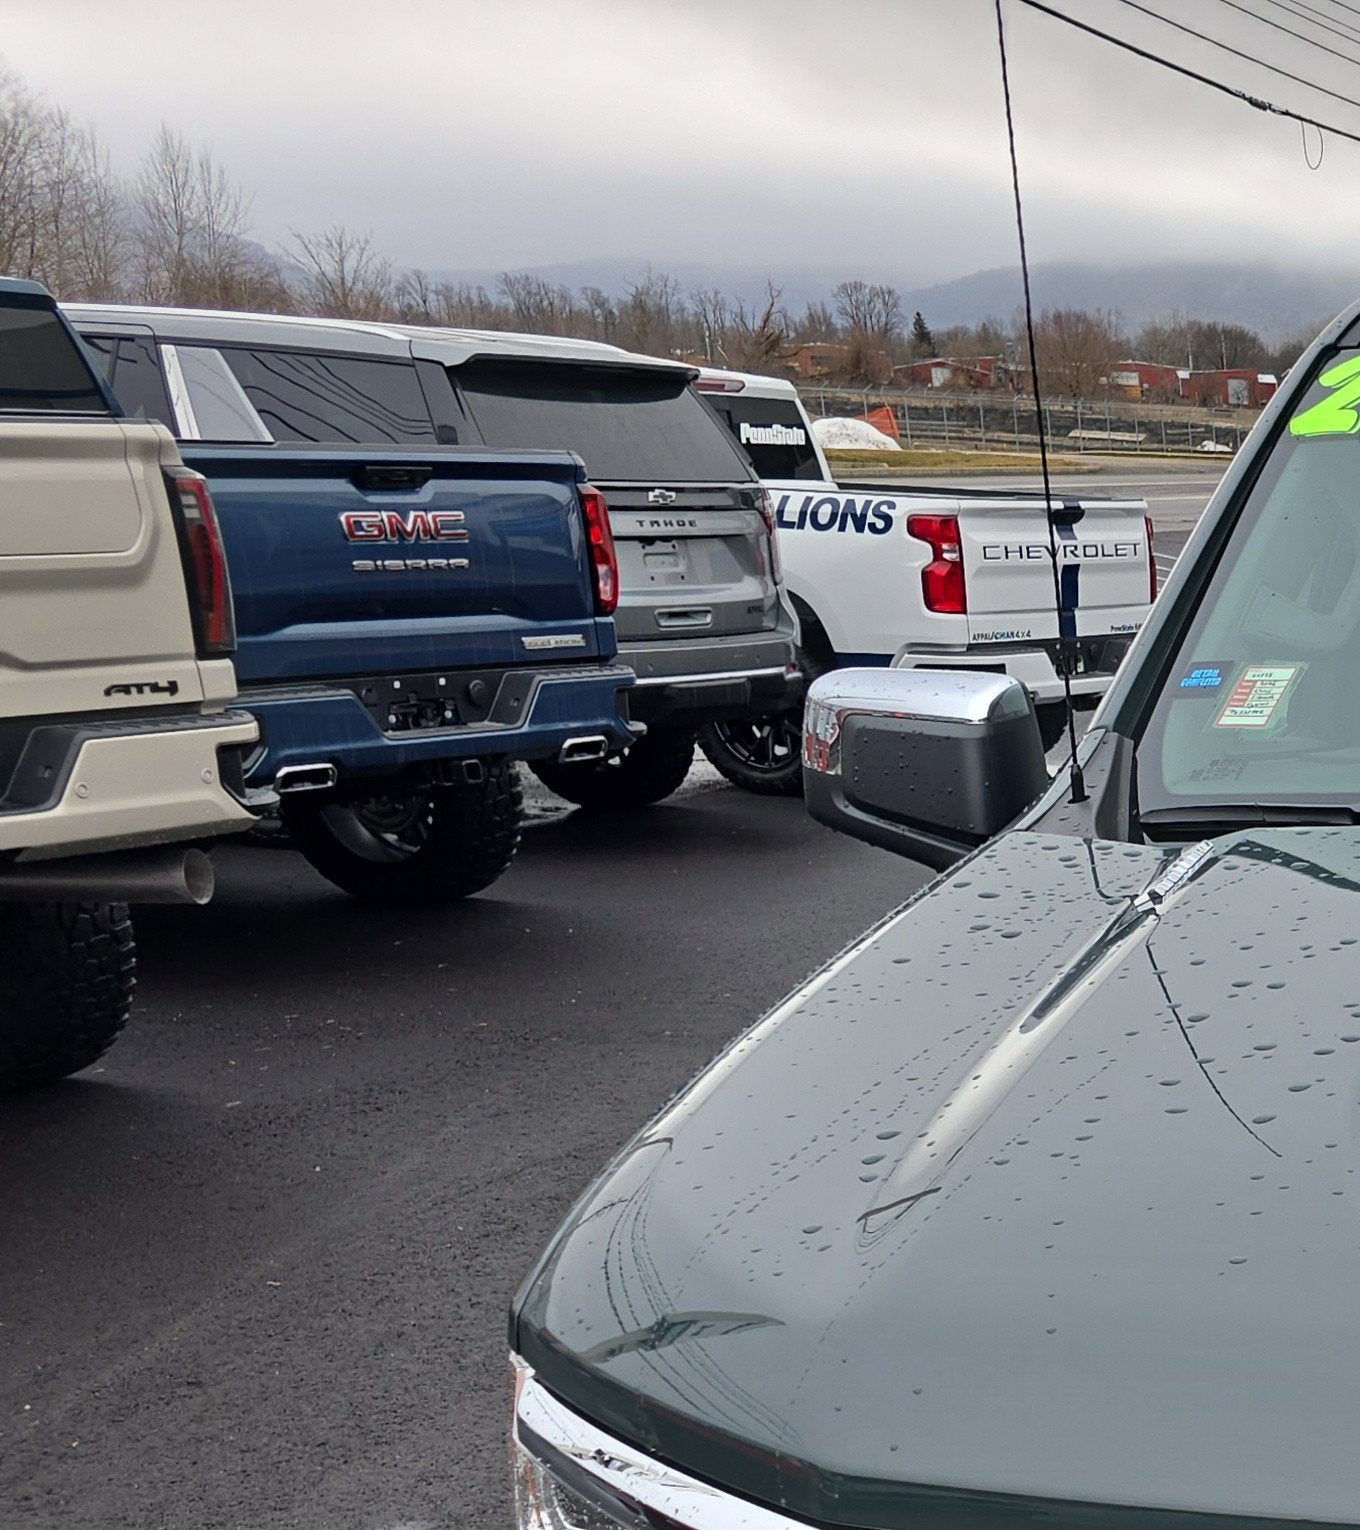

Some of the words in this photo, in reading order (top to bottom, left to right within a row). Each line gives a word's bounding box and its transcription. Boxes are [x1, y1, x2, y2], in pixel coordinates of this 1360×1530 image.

[635, 519, 698, 528] TAHOE
[776, 494, 897, 536] LIONS
[339, 510, 470, 543] GMC
[982, 541, 1141, 561] CHEVROLET
[352, 557, 469, 572] SIERRA
[103, 679, 179, 698] AT4
